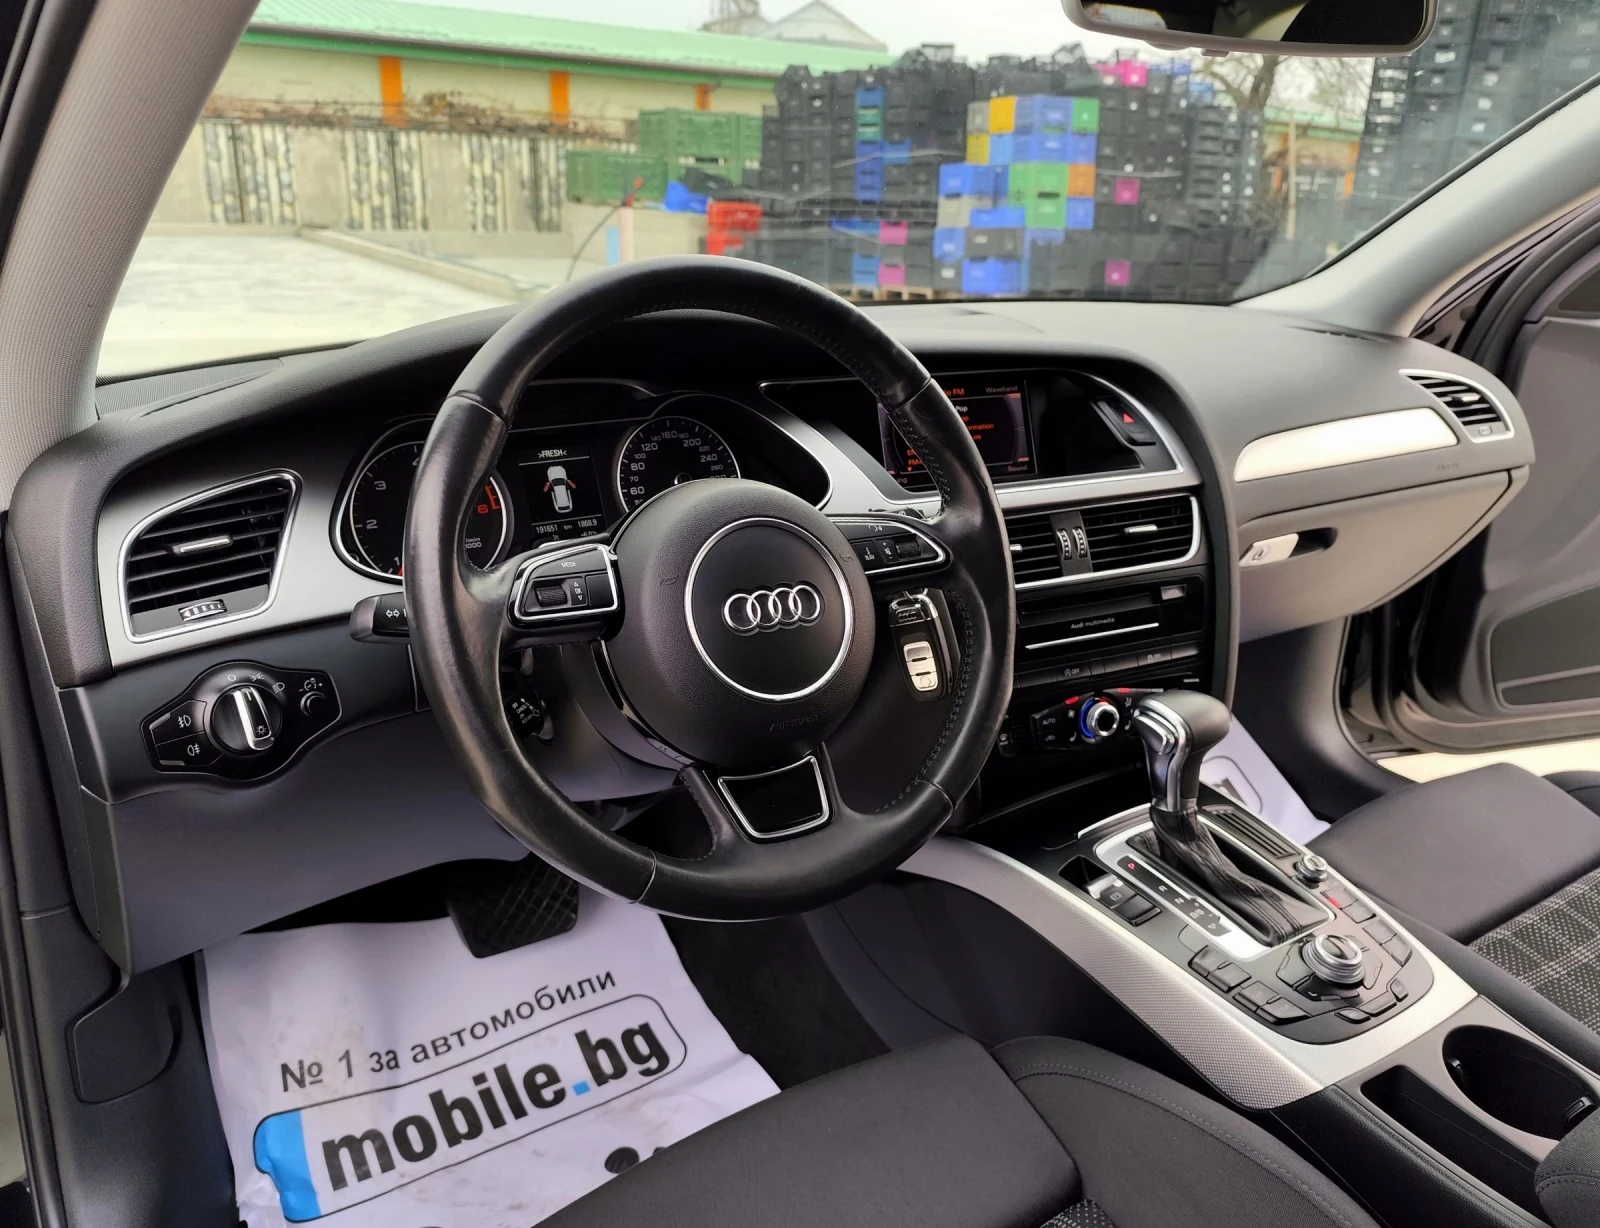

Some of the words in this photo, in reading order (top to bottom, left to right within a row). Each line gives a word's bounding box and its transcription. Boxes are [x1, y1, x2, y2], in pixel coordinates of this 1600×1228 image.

[661, 430, 678, 439] 160
[641, 442, 658, 451] 120
[683, 438, 701, 447] 200
[700, 454, 718, 462] 240
[630, 462, 645, 471] 80
[374, 480, 387, 490] 3
[630, 486, 645, 495] 60
[477, 504, 489, 514] 6
[366, 519, 378, 530] 2
[560, 560, 578, 568] MODE
[1070, 622, 1084, 630] Audi
[1084, 617, 1116, 628] multimedia
[1042, 717, 1056, 726] AUTO
[338, 1048, 353, 1078] 1
[369, 1049, 400, 1073] за
[410, 970, 616, 1064] автомобили
[321, 1021, 671, 1192] mobile.bg
